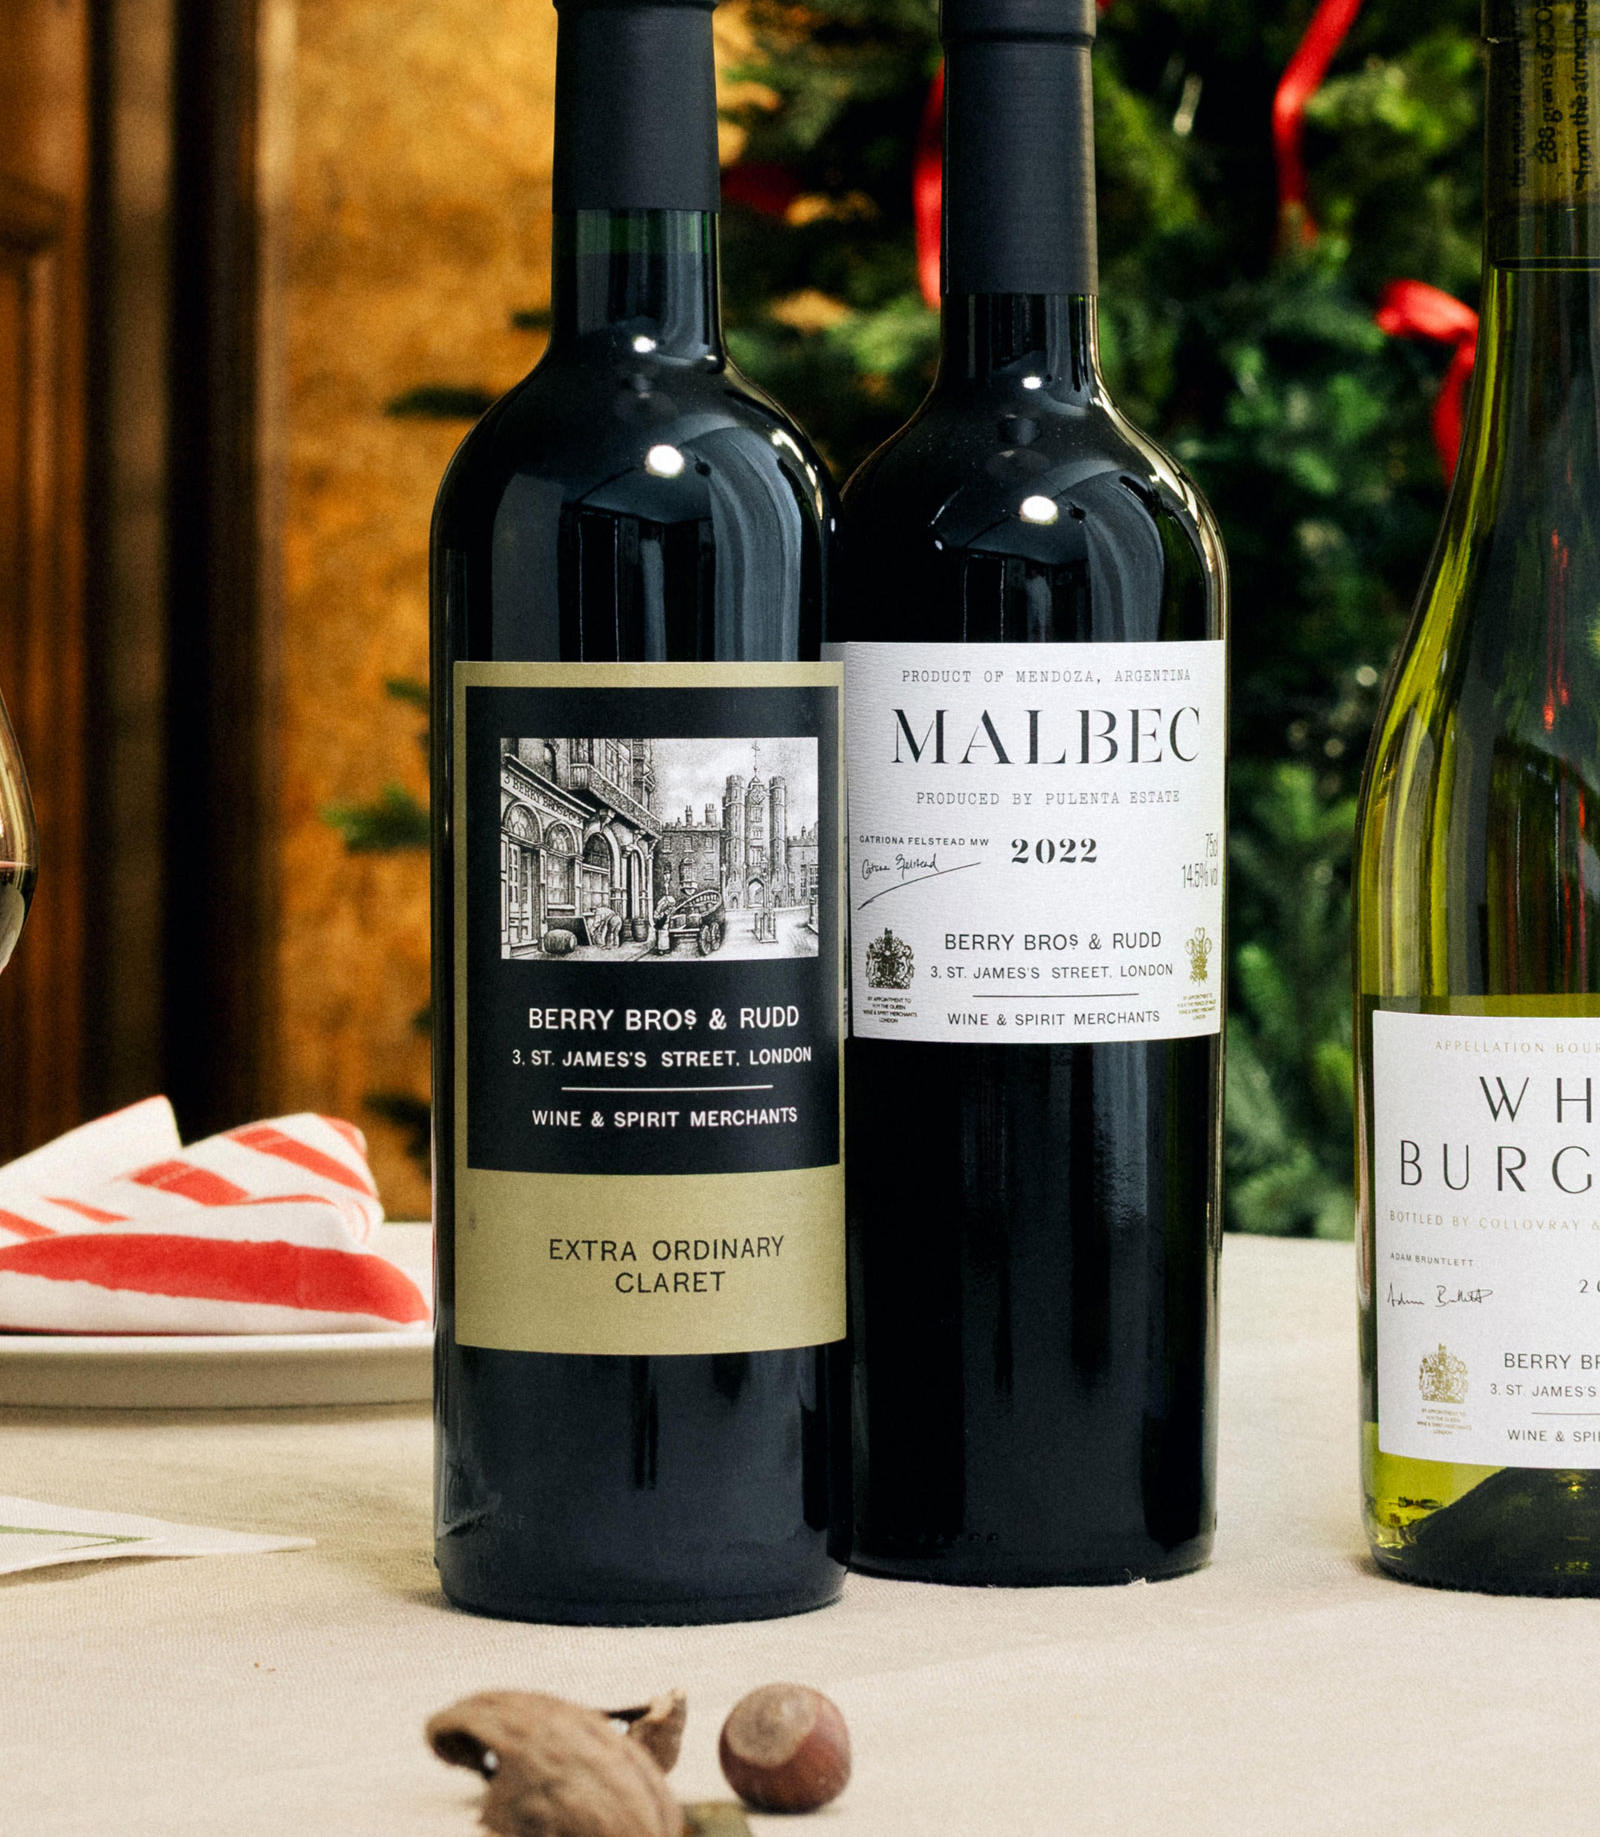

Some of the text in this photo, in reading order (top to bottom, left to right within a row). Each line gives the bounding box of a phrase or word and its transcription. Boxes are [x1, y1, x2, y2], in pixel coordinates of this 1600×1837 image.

[1572, 96, 1590, 126] the
[1537, 126, 1558, 165] 288
[901, 668, 1191, 685] PRODUCT OF MENDOZA, ARGENTINA
[890, 706, 1200, 765] MALBEC
[915, 789, 1180, 806] PRODUCED BY PULENTA ESTATE
[859, 833, 990, 847] CATRIONA FELSTEAD MW
[1010, 838, 1098, 863] 2022
[944, 933, 1015, 951] BERRY
[1088, 932, 1102, 951] &
[1112, 931, 1162, 950] RUDD
[946, 966, 967, 979] ST.
[972, 966, 1041, 980] JAMES'S
[1120, 962, 1173, 978] LONDON
[528, 1007, 615, 1031] BERRY
[708, 1007, 728, 1031] &
[740, 1005, 800, 1029] RUDD
[946, 1009, 1161, 1027] WINE & SPIRIT MERCHANTS
[531, 1049, 555, 1066] ST.
[561, 1050, 647, 1068] JAMES'S
[749, 1046, 812, 1066] LONDON
[1434, 1040, 1545, 1054] APPELLATION
[531, 1106, 798, 1128] WINE & SPIRIT MERCHANTS
[1389, 1210, 1444, 1226] BOTTLED
[1451, 1215, 1470, 1227] BY
[1591, 1218, 1600, 1231] &
[548, 1234, 785, 1263] EXTRA ORDINARY
[1390, 1252, 1473, 1267] ADAM BRUNTLETT
[614, 1270, 726, 1295] CLARET
[1503, 1352, 1572, 1370] BERRY
[1531, 1385, 1597, 1398] JAMES'S
[1507, 1428, 1548, 1442] WINE
[1554, 1430, 1566, 1443] &
